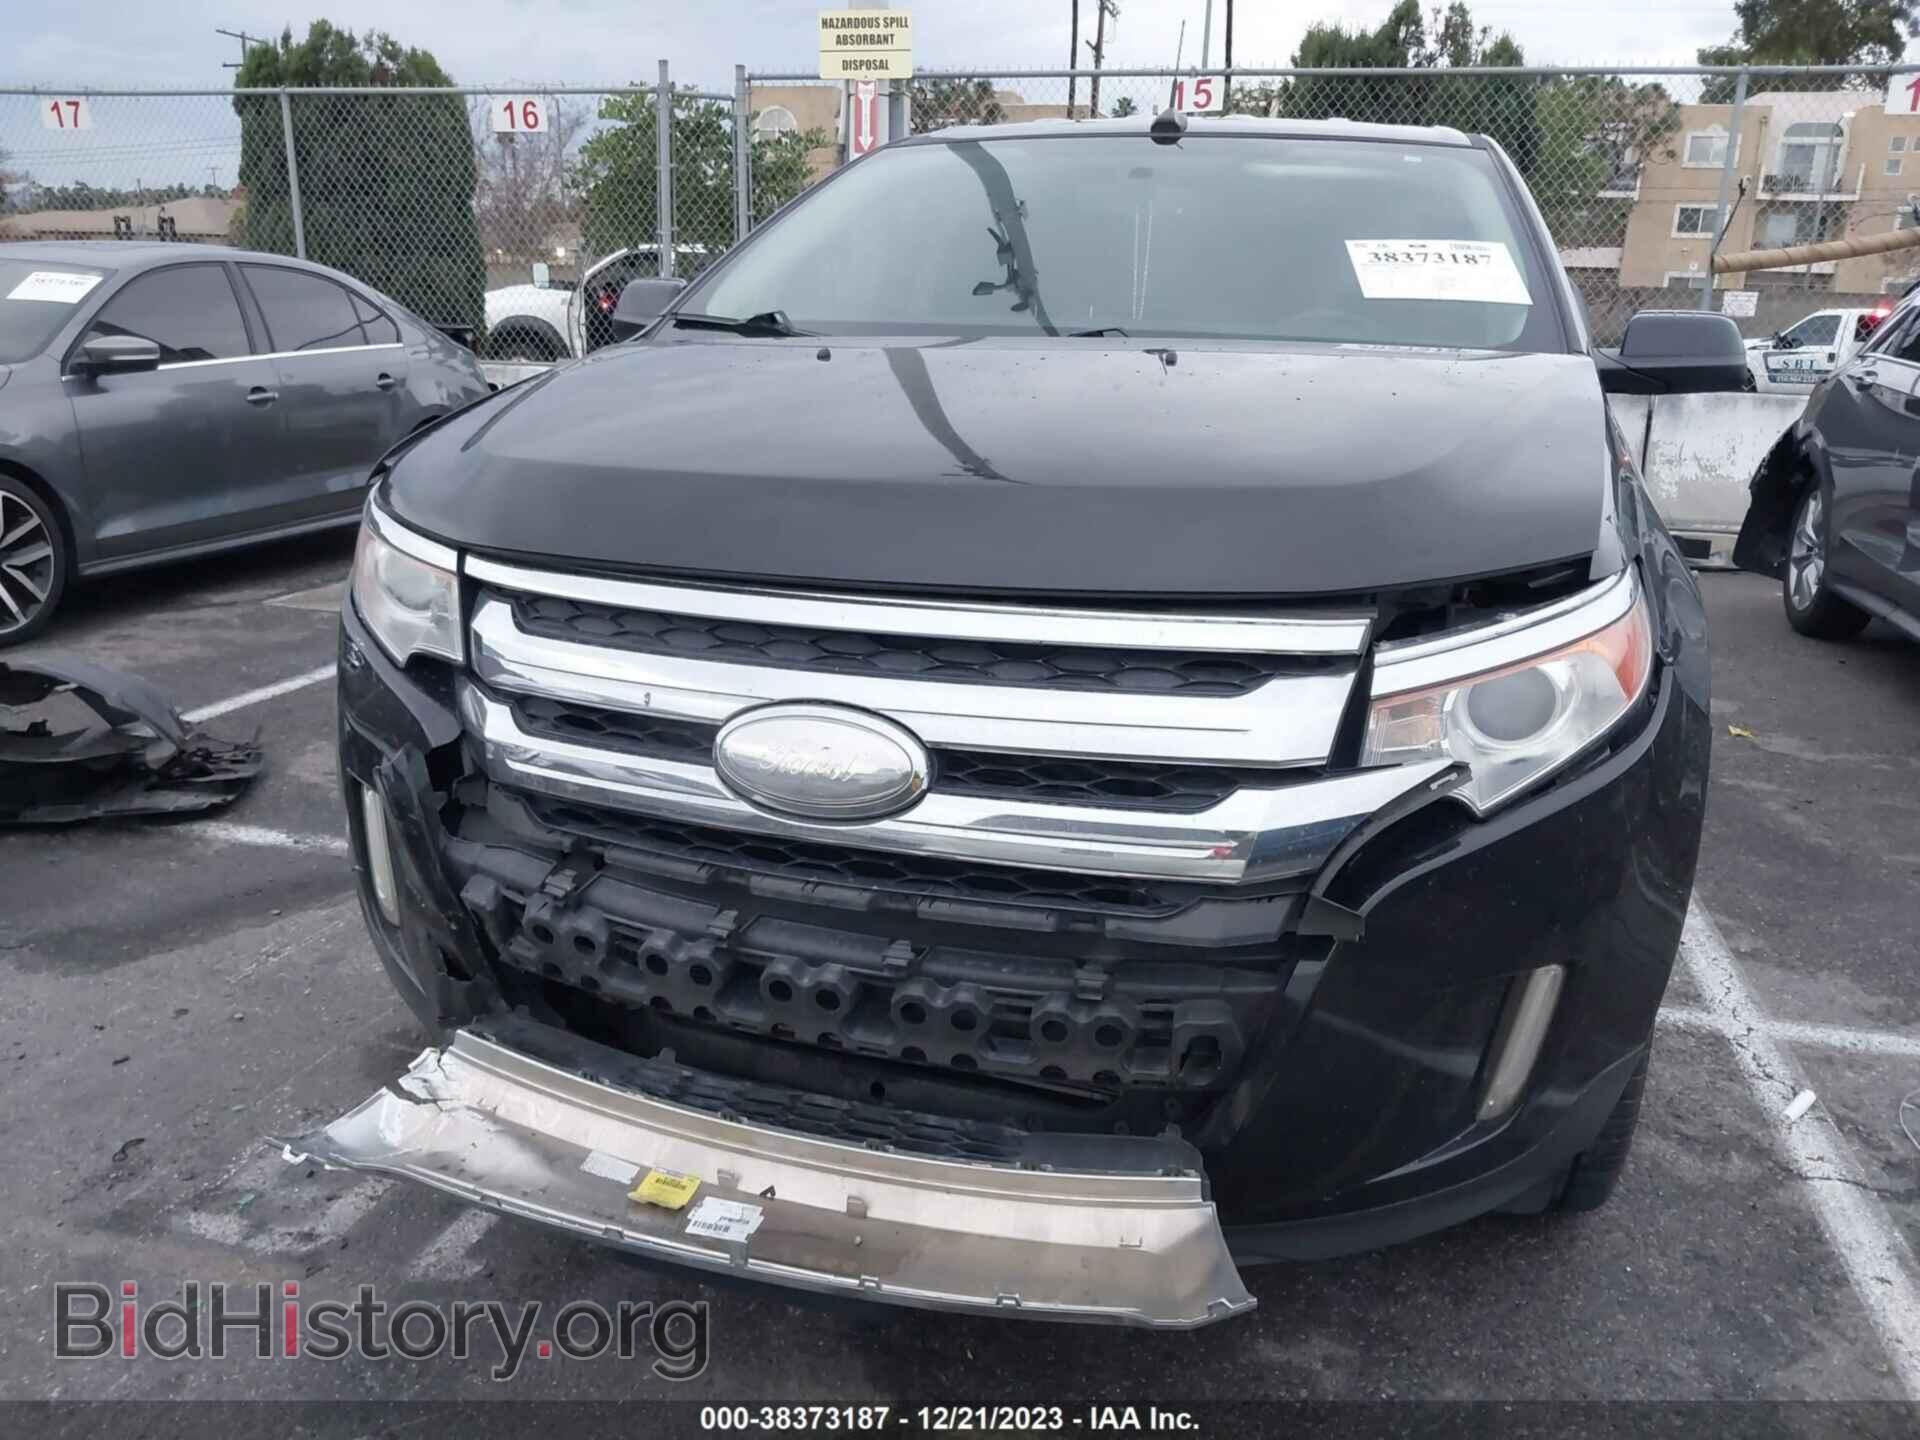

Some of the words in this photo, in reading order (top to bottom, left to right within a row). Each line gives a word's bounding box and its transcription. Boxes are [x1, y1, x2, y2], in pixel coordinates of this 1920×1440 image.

[821, 18, 881, 29] HAZARDOUS
[882, 16, 909, 28] SPILL
[835, 34, 895, 46] ABSORBANT
[841, 59, 890, 71] DISPOSAL
[1175, 78, 1212, 111] 15
[1905, 77, 1920, 112] 1
[50, 100, 80, 128] 17
[503, 100, 539, 130] 16
[1367, 251, 1492, 265] 38373187
